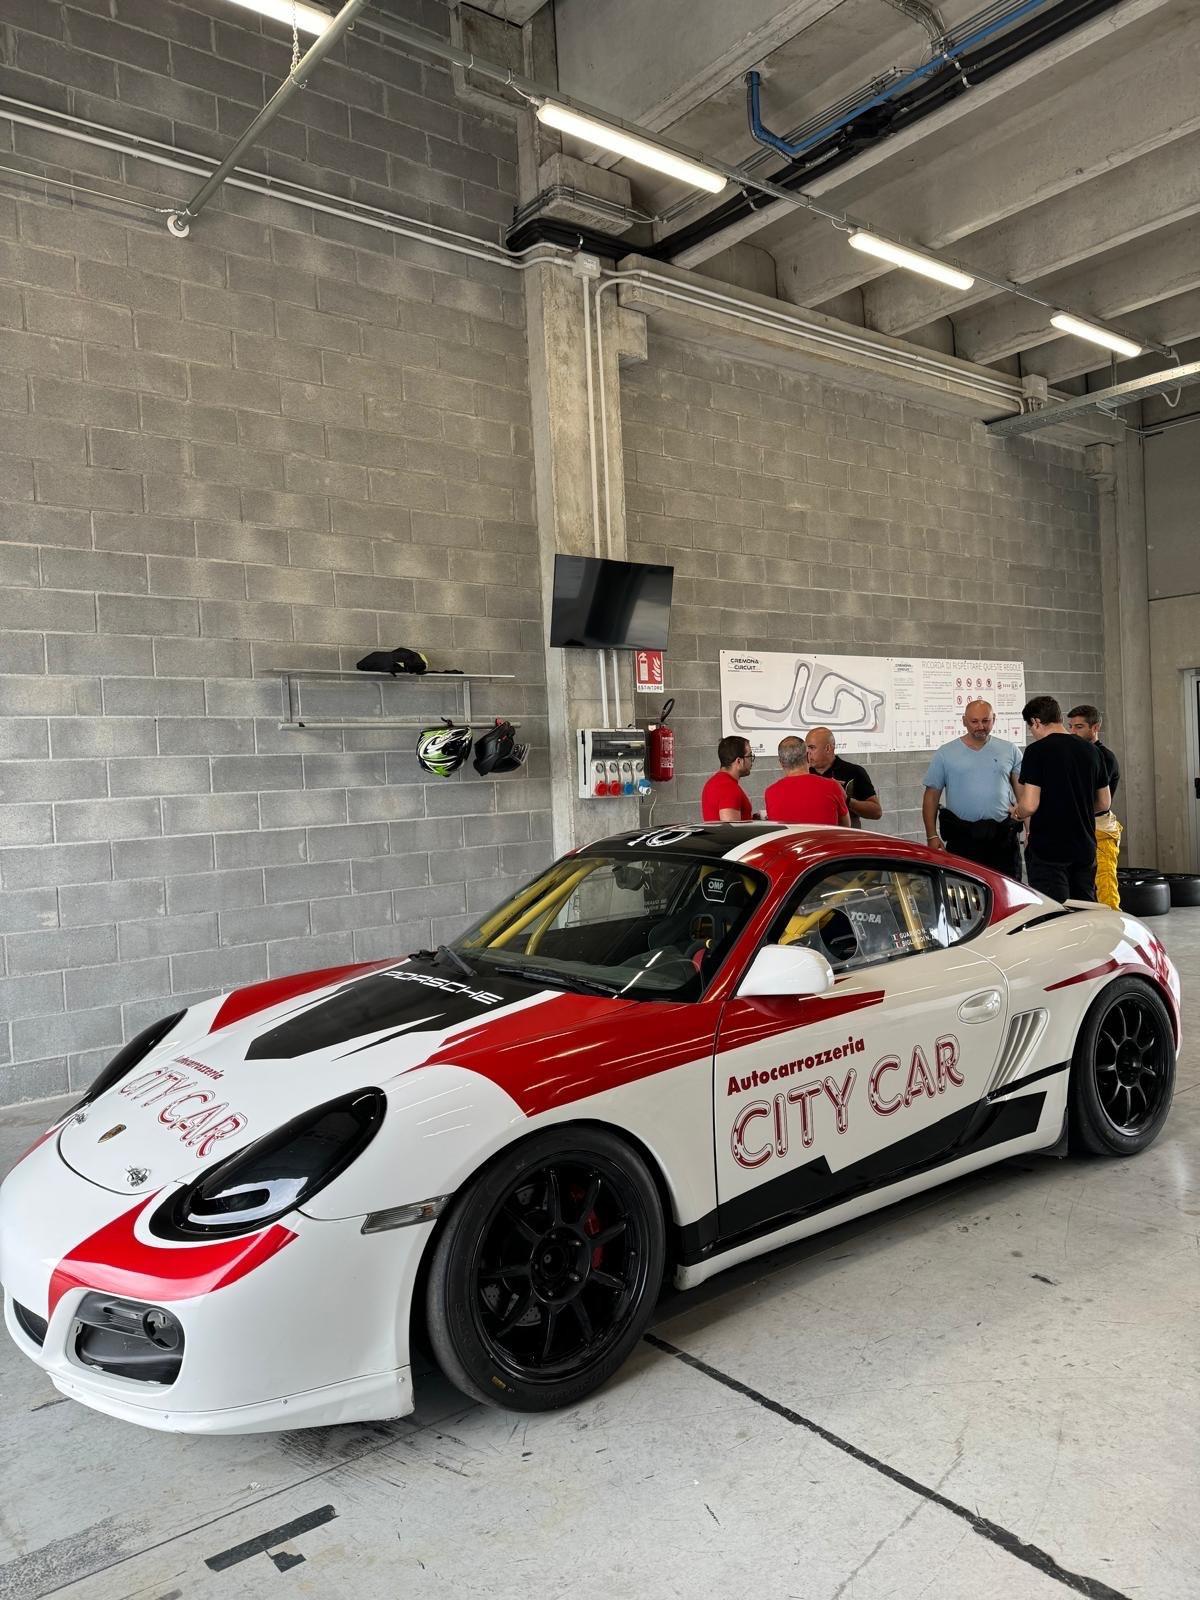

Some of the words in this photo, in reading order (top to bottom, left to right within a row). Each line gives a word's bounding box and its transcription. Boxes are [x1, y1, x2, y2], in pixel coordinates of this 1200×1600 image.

[708, 881, 724, 890] OMP
[379, 970, 504, 1005] PORSCHE
[727, 1036, 865, 1096] Autocarrozzeria
[118, 1066, 198, 1108] CITY
[158, 1101, 248, 1158] CAR
[731, 1068, 857, 1169] CITY
[868, 1034, 964, 1116] CAR
